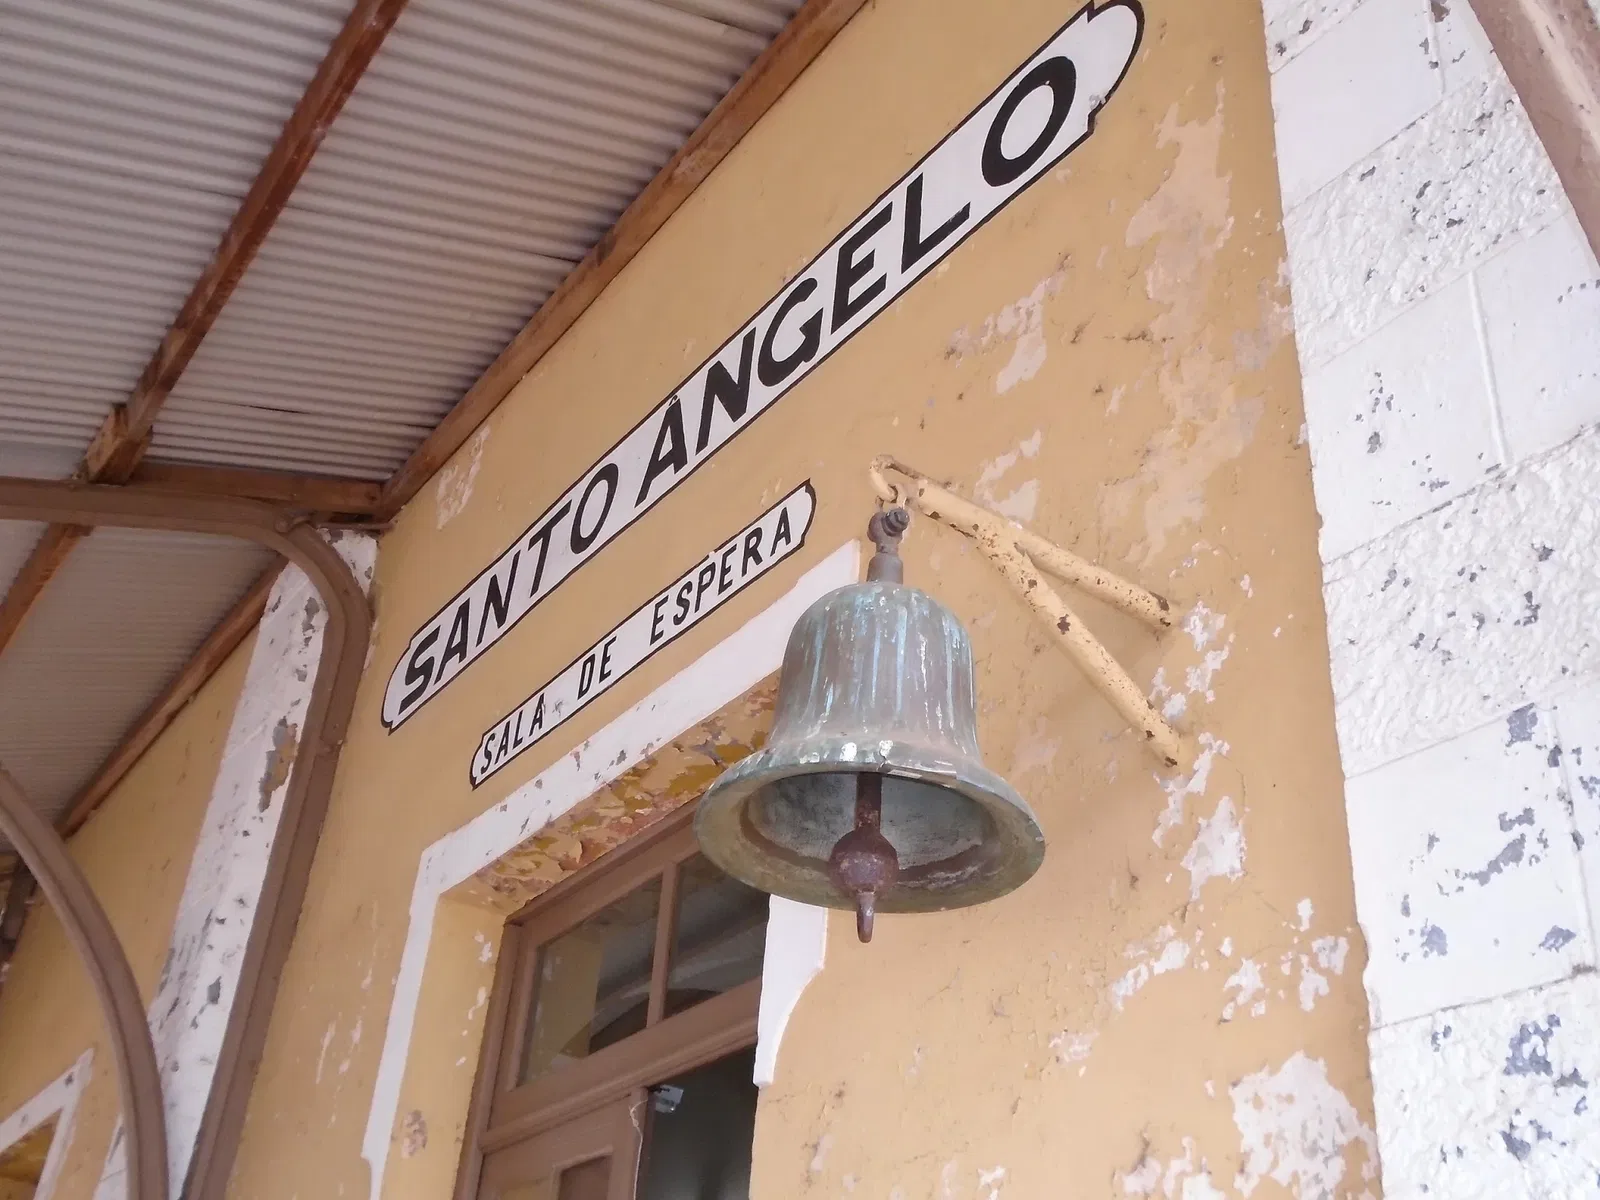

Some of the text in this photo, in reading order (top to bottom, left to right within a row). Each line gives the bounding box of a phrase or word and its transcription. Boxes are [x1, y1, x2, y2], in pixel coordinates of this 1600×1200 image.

[399, 56, 1077, 715] SANTO ÂNGELO
[480, 507, 792, 773] SALA DE ESPERA
